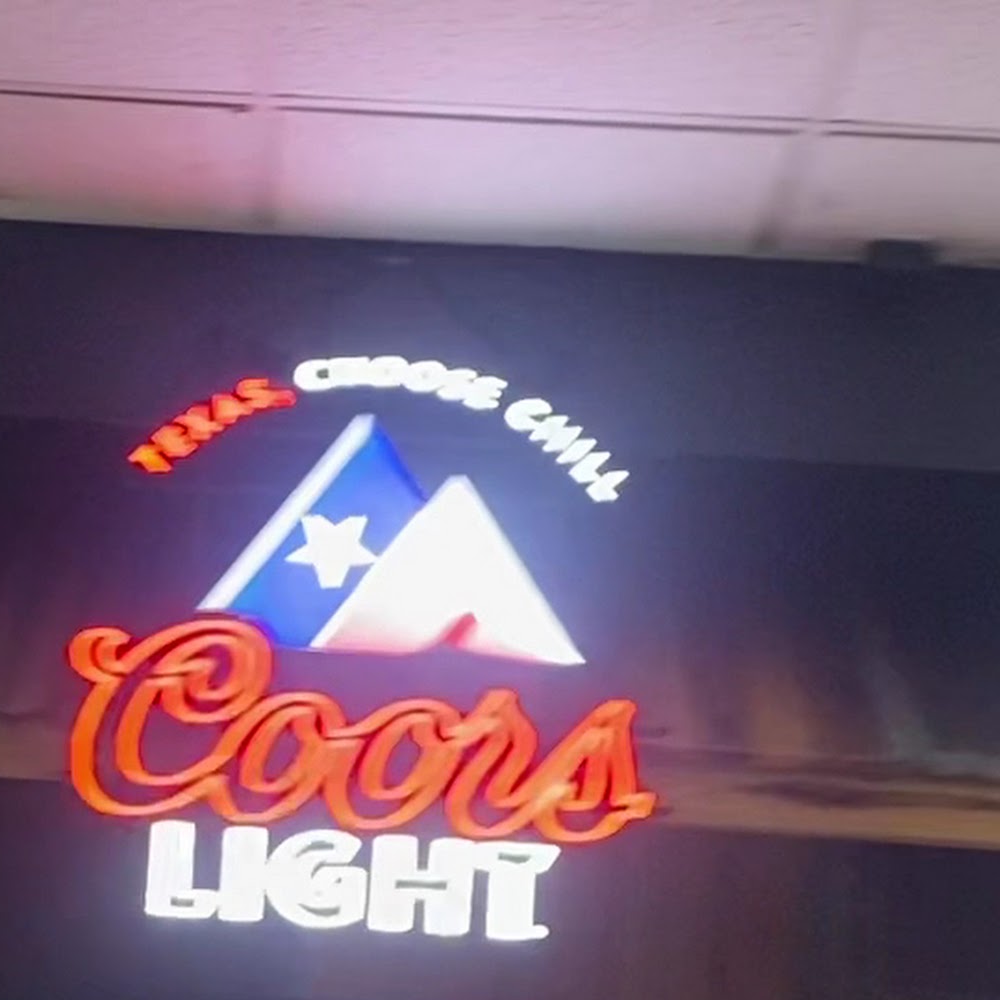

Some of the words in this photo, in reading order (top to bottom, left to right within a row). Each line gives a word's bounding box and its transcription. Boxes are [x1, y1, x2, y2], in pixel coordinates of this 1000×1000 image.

[293, 355, 508, 411] CHOOSE
[504, 398, 630, 503] CHILL
[67, 617, 659, 843] Coors
[144, 819, 561, 942] LIGHT
